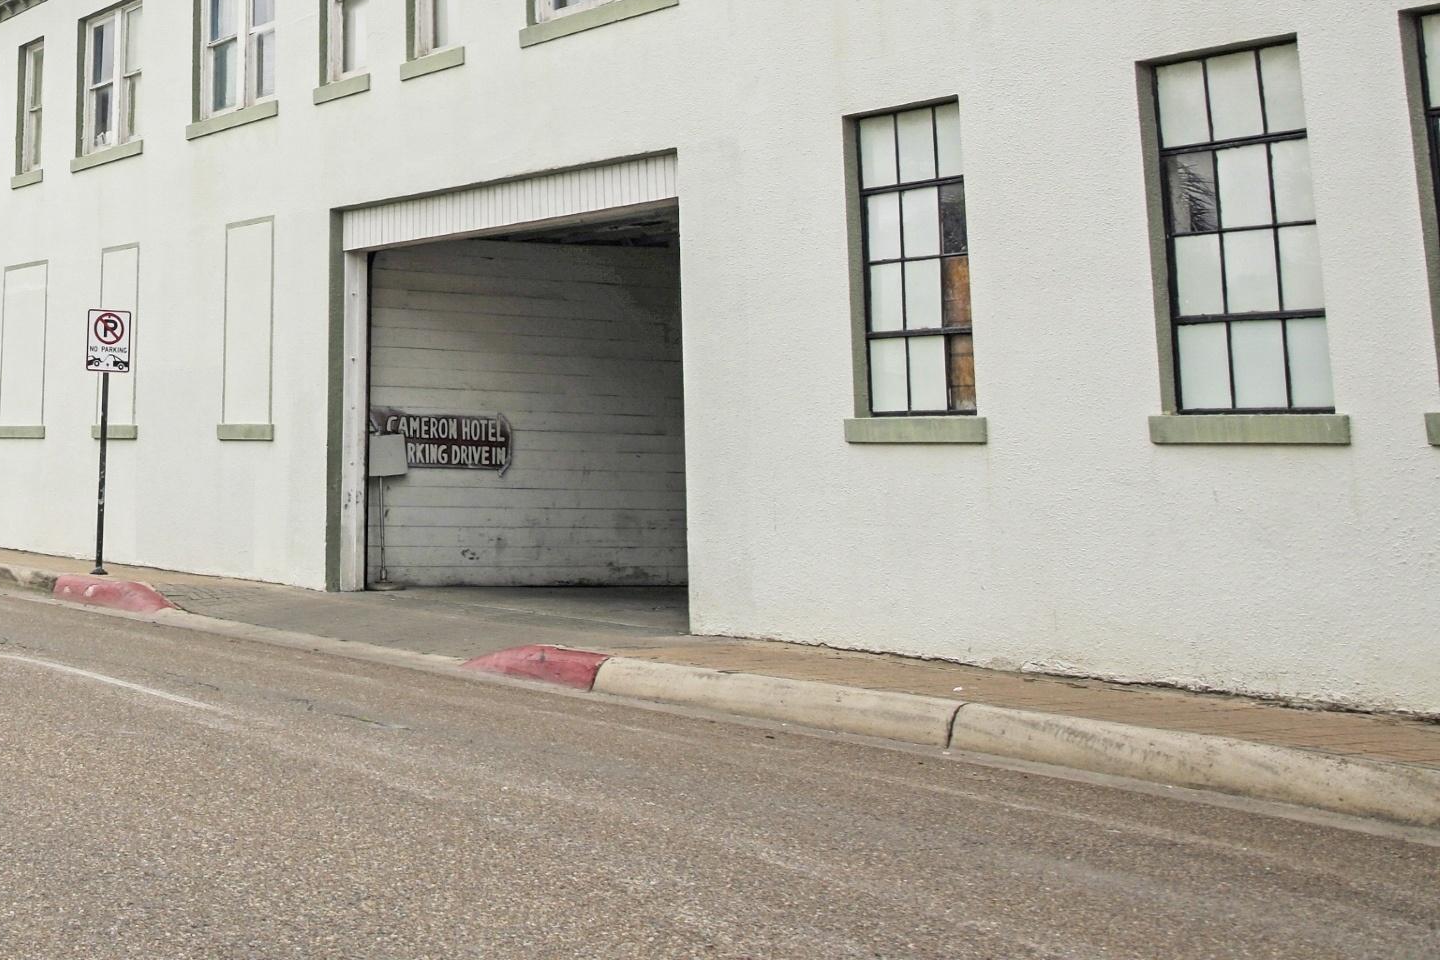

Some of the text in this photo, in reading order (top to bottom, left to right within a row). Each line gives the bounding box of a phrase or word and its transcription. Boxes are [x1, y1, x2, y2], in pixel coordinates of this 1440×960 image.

[101, 345, 127, 353] PARKING
[386, 416, 506, 442] CAMERON HOTEL
[451, 444, 490, 465] DRIVE
[491, 446, 506, 465] IN
